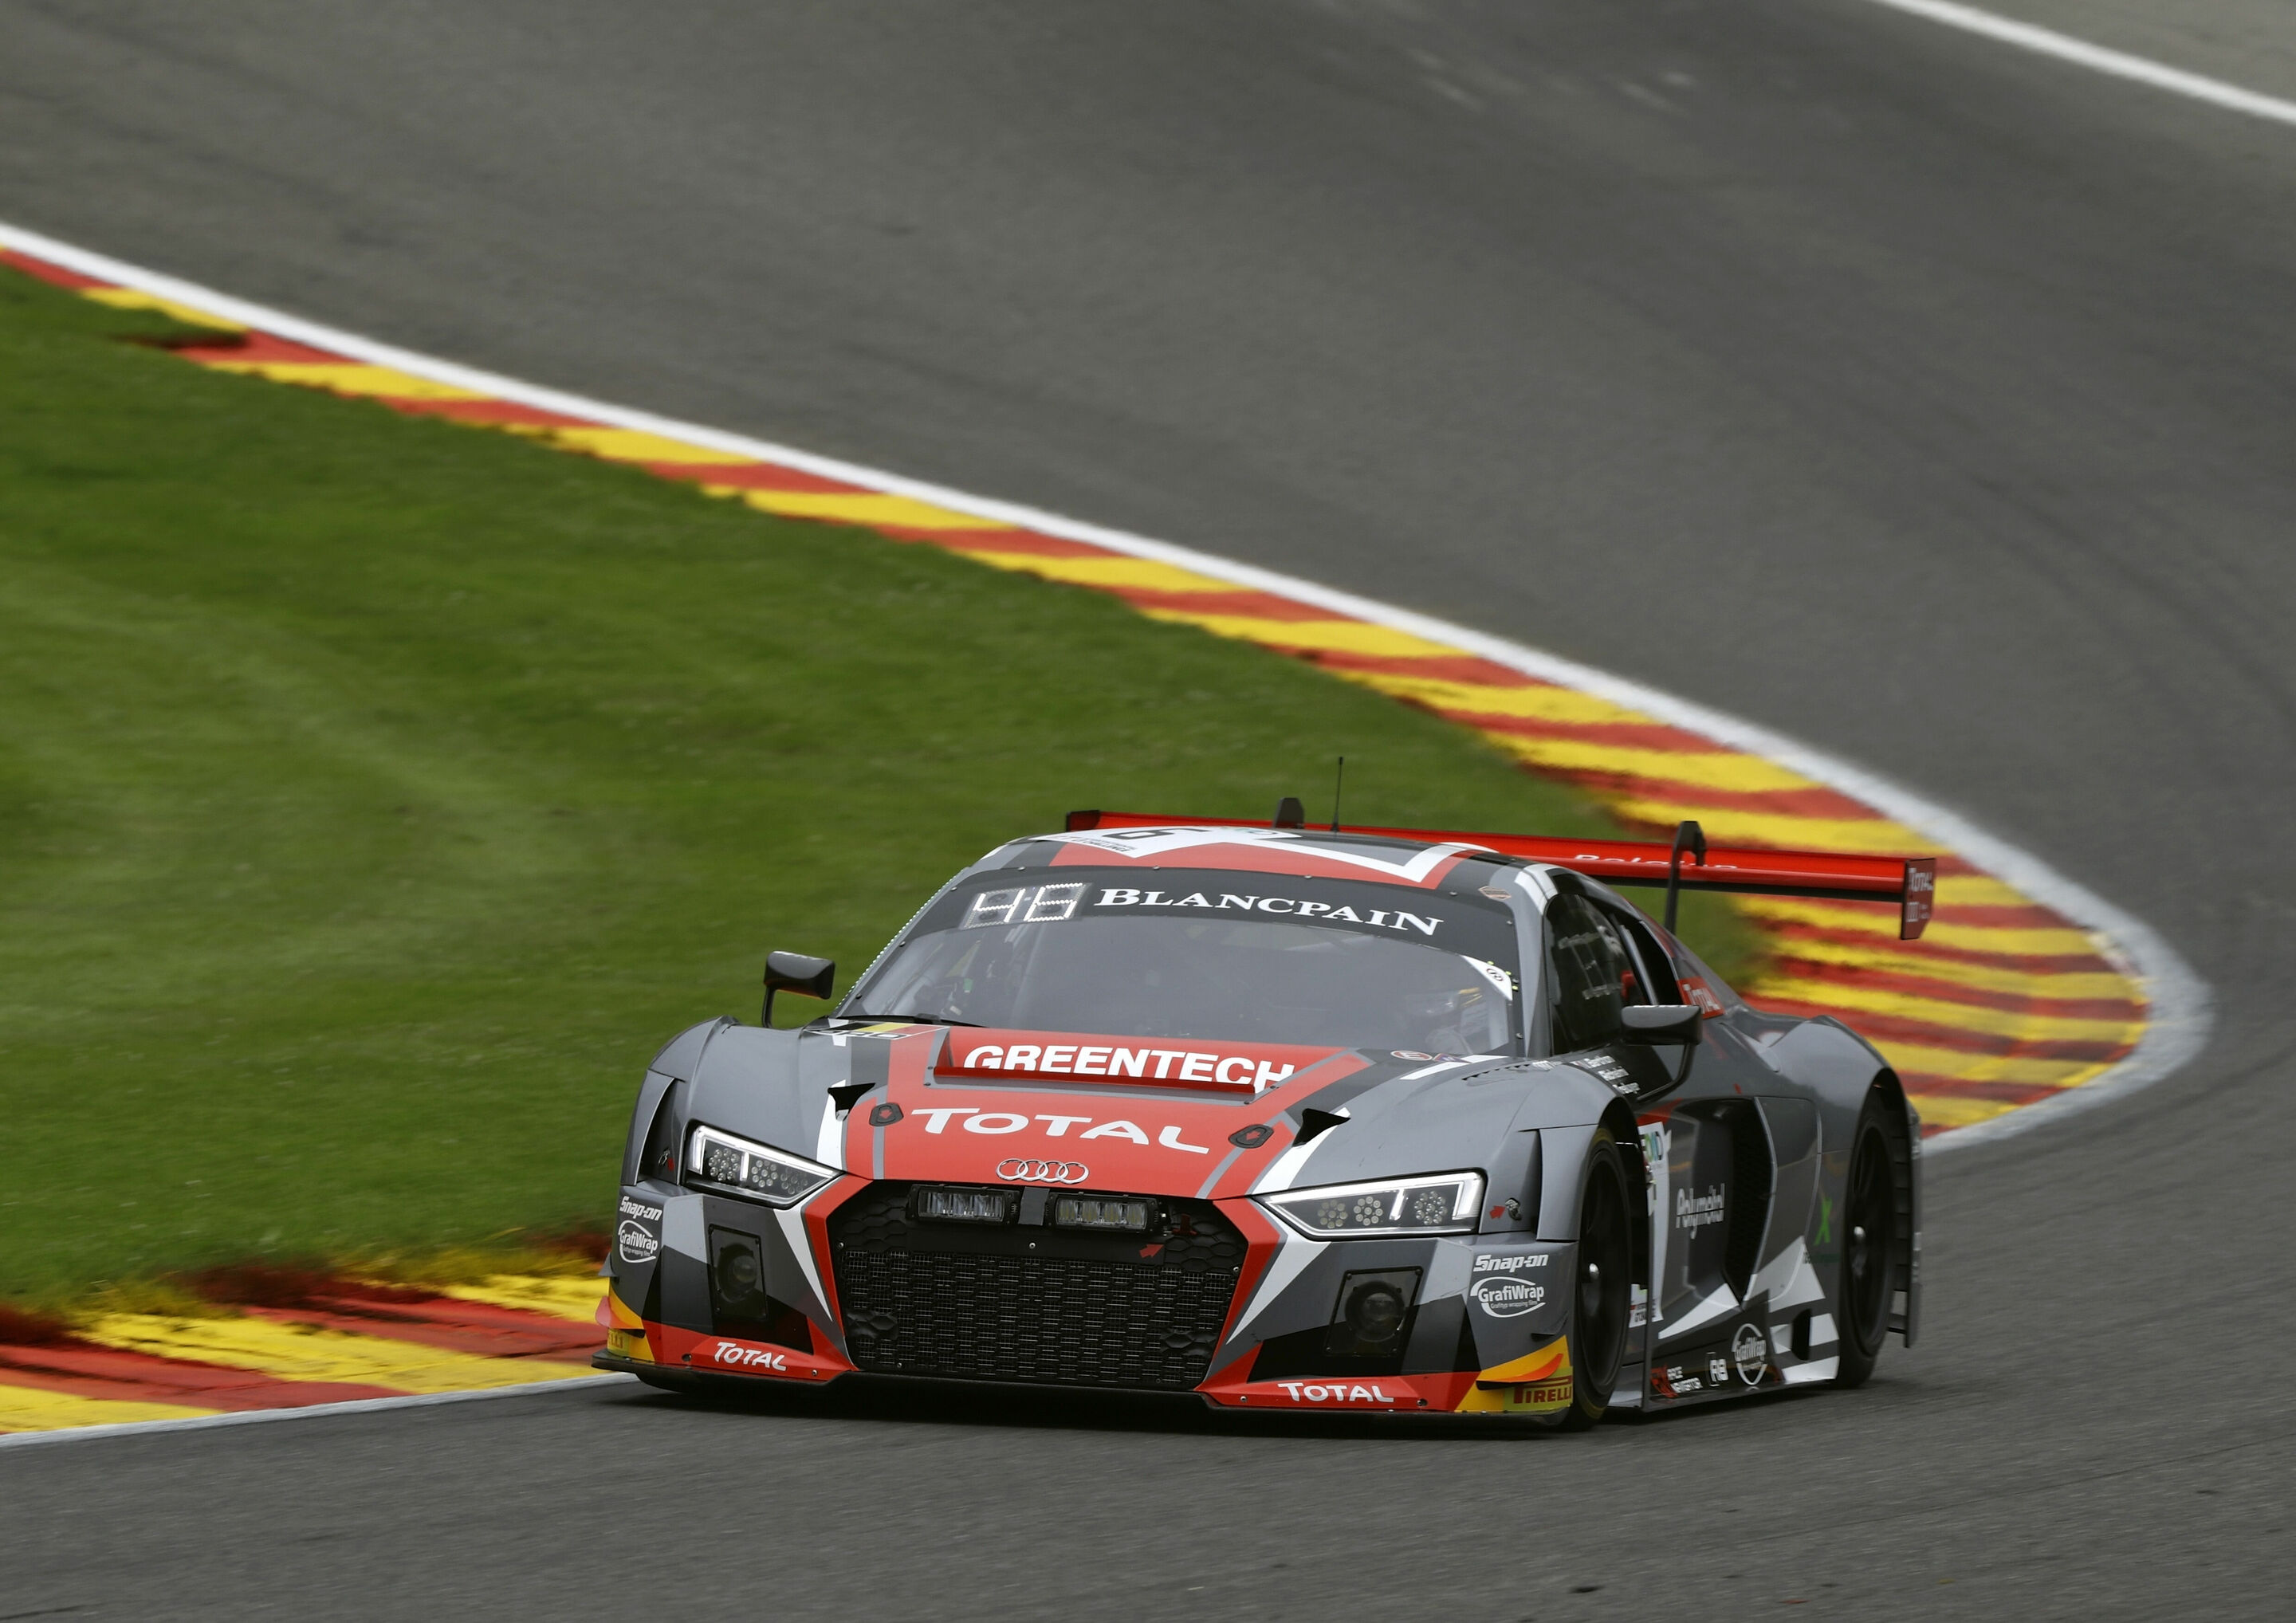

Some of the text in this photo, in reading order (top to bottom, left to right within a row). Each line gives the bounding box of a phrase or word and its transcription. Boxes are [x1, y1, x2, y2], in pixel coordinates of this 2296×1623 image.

[1094, 888, 1444, 936] BLANCPAIN
[963, 1045, 1295, 1093] GREENTECH
[911, 1108, 1210, 1154] TOTAL
[619, 1196, 662, 1220] Snap-on
[619, 1230, 659, 1254] GrafiWrap
[1472, 1254, 1549, 1273] Snap-on
[1478, 1285, 1545, 1303] GrafiWrap
[714, 1342, 788, 1372] TOTAL
[1277, 1382, 1394, 1403] TOTAL
[1513, 1376, 1572, 1404] PIRELLI
